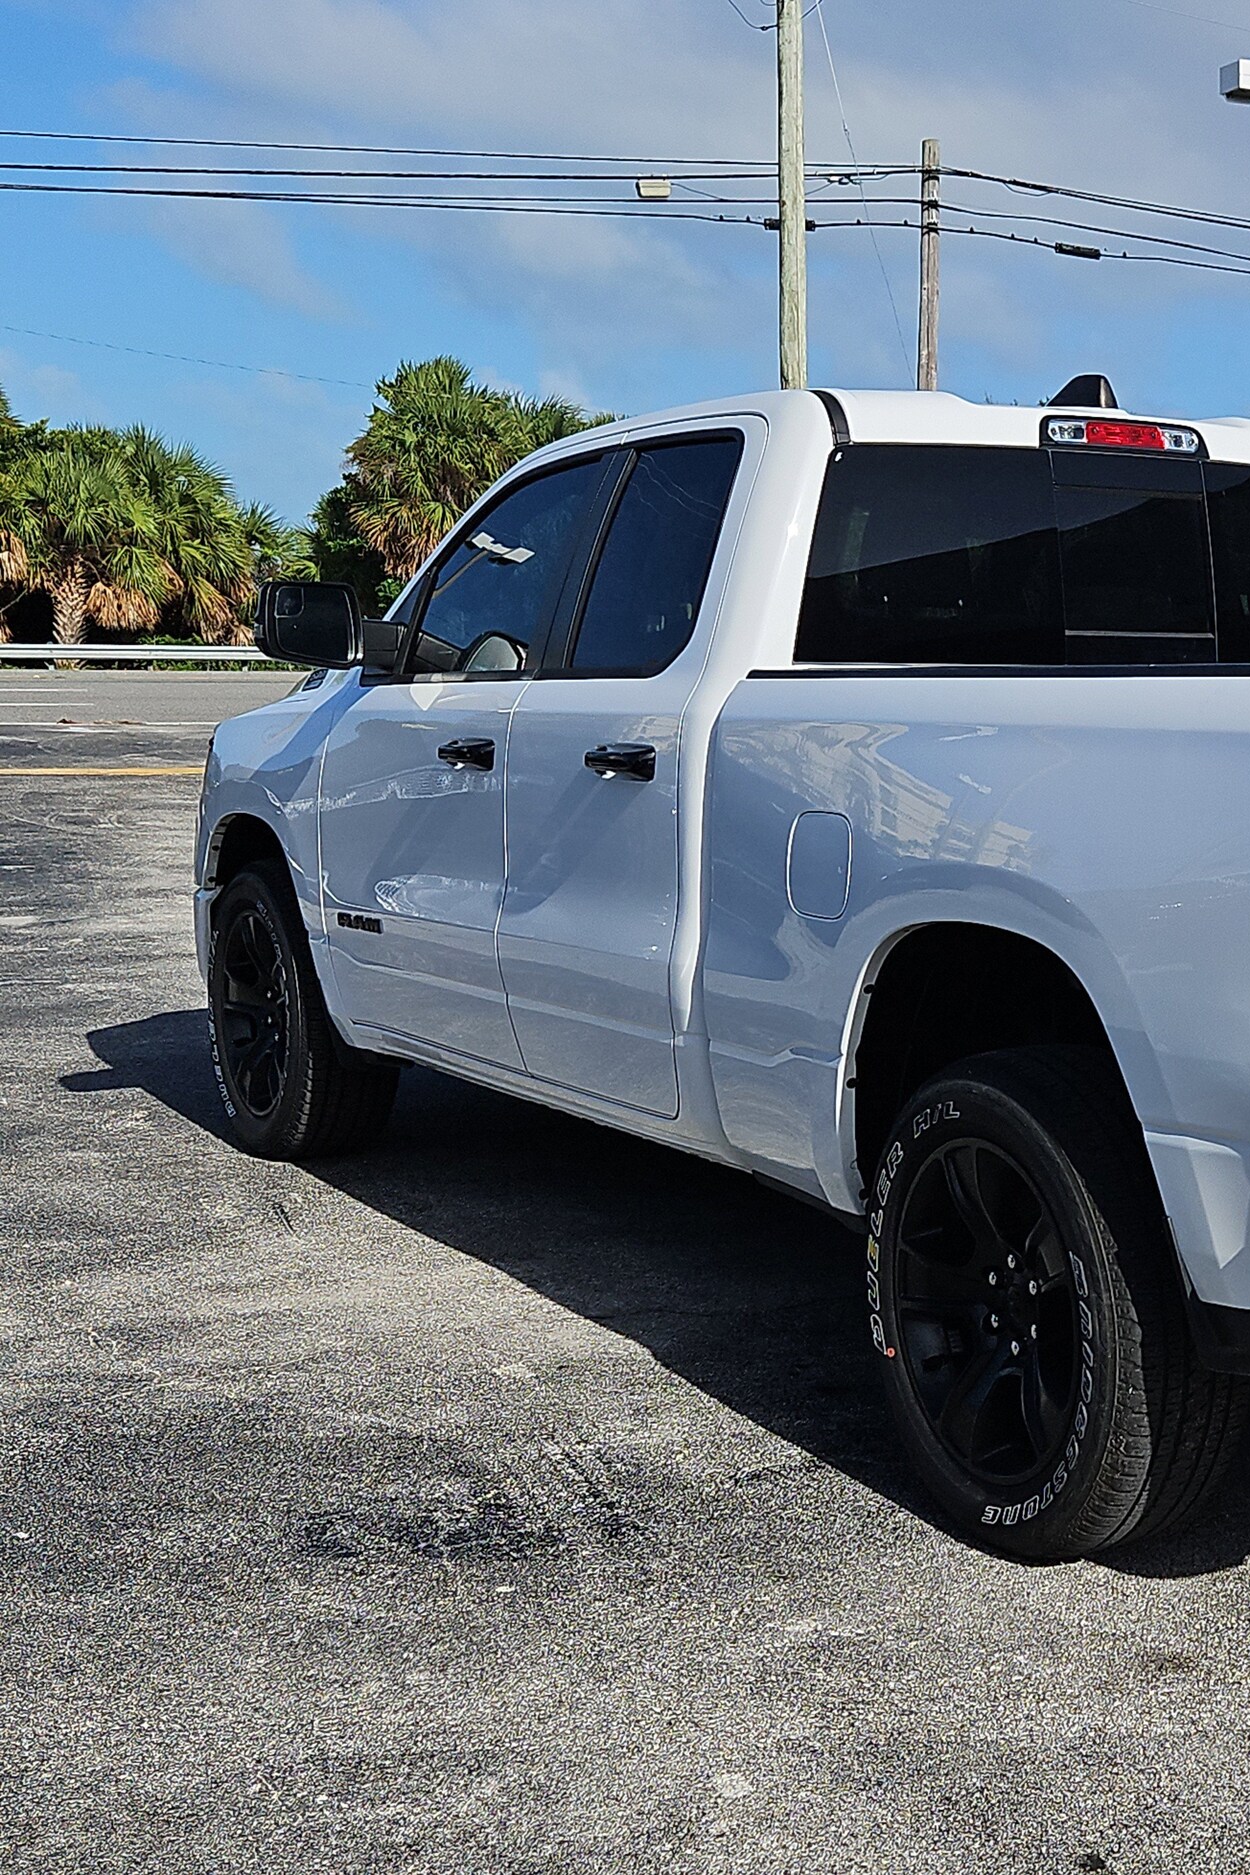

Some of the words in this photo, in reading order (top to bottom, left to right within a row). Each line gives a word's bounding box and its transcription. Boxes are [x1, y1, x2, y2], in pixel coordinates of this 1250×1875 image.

[337, 912, 384, 934] RAM
[867, 1141, 904, 1355] DUELER
[913, 1101, 960, 1138] H/L
[981, 1250, 1093, 1525] BRIDGESTONE
